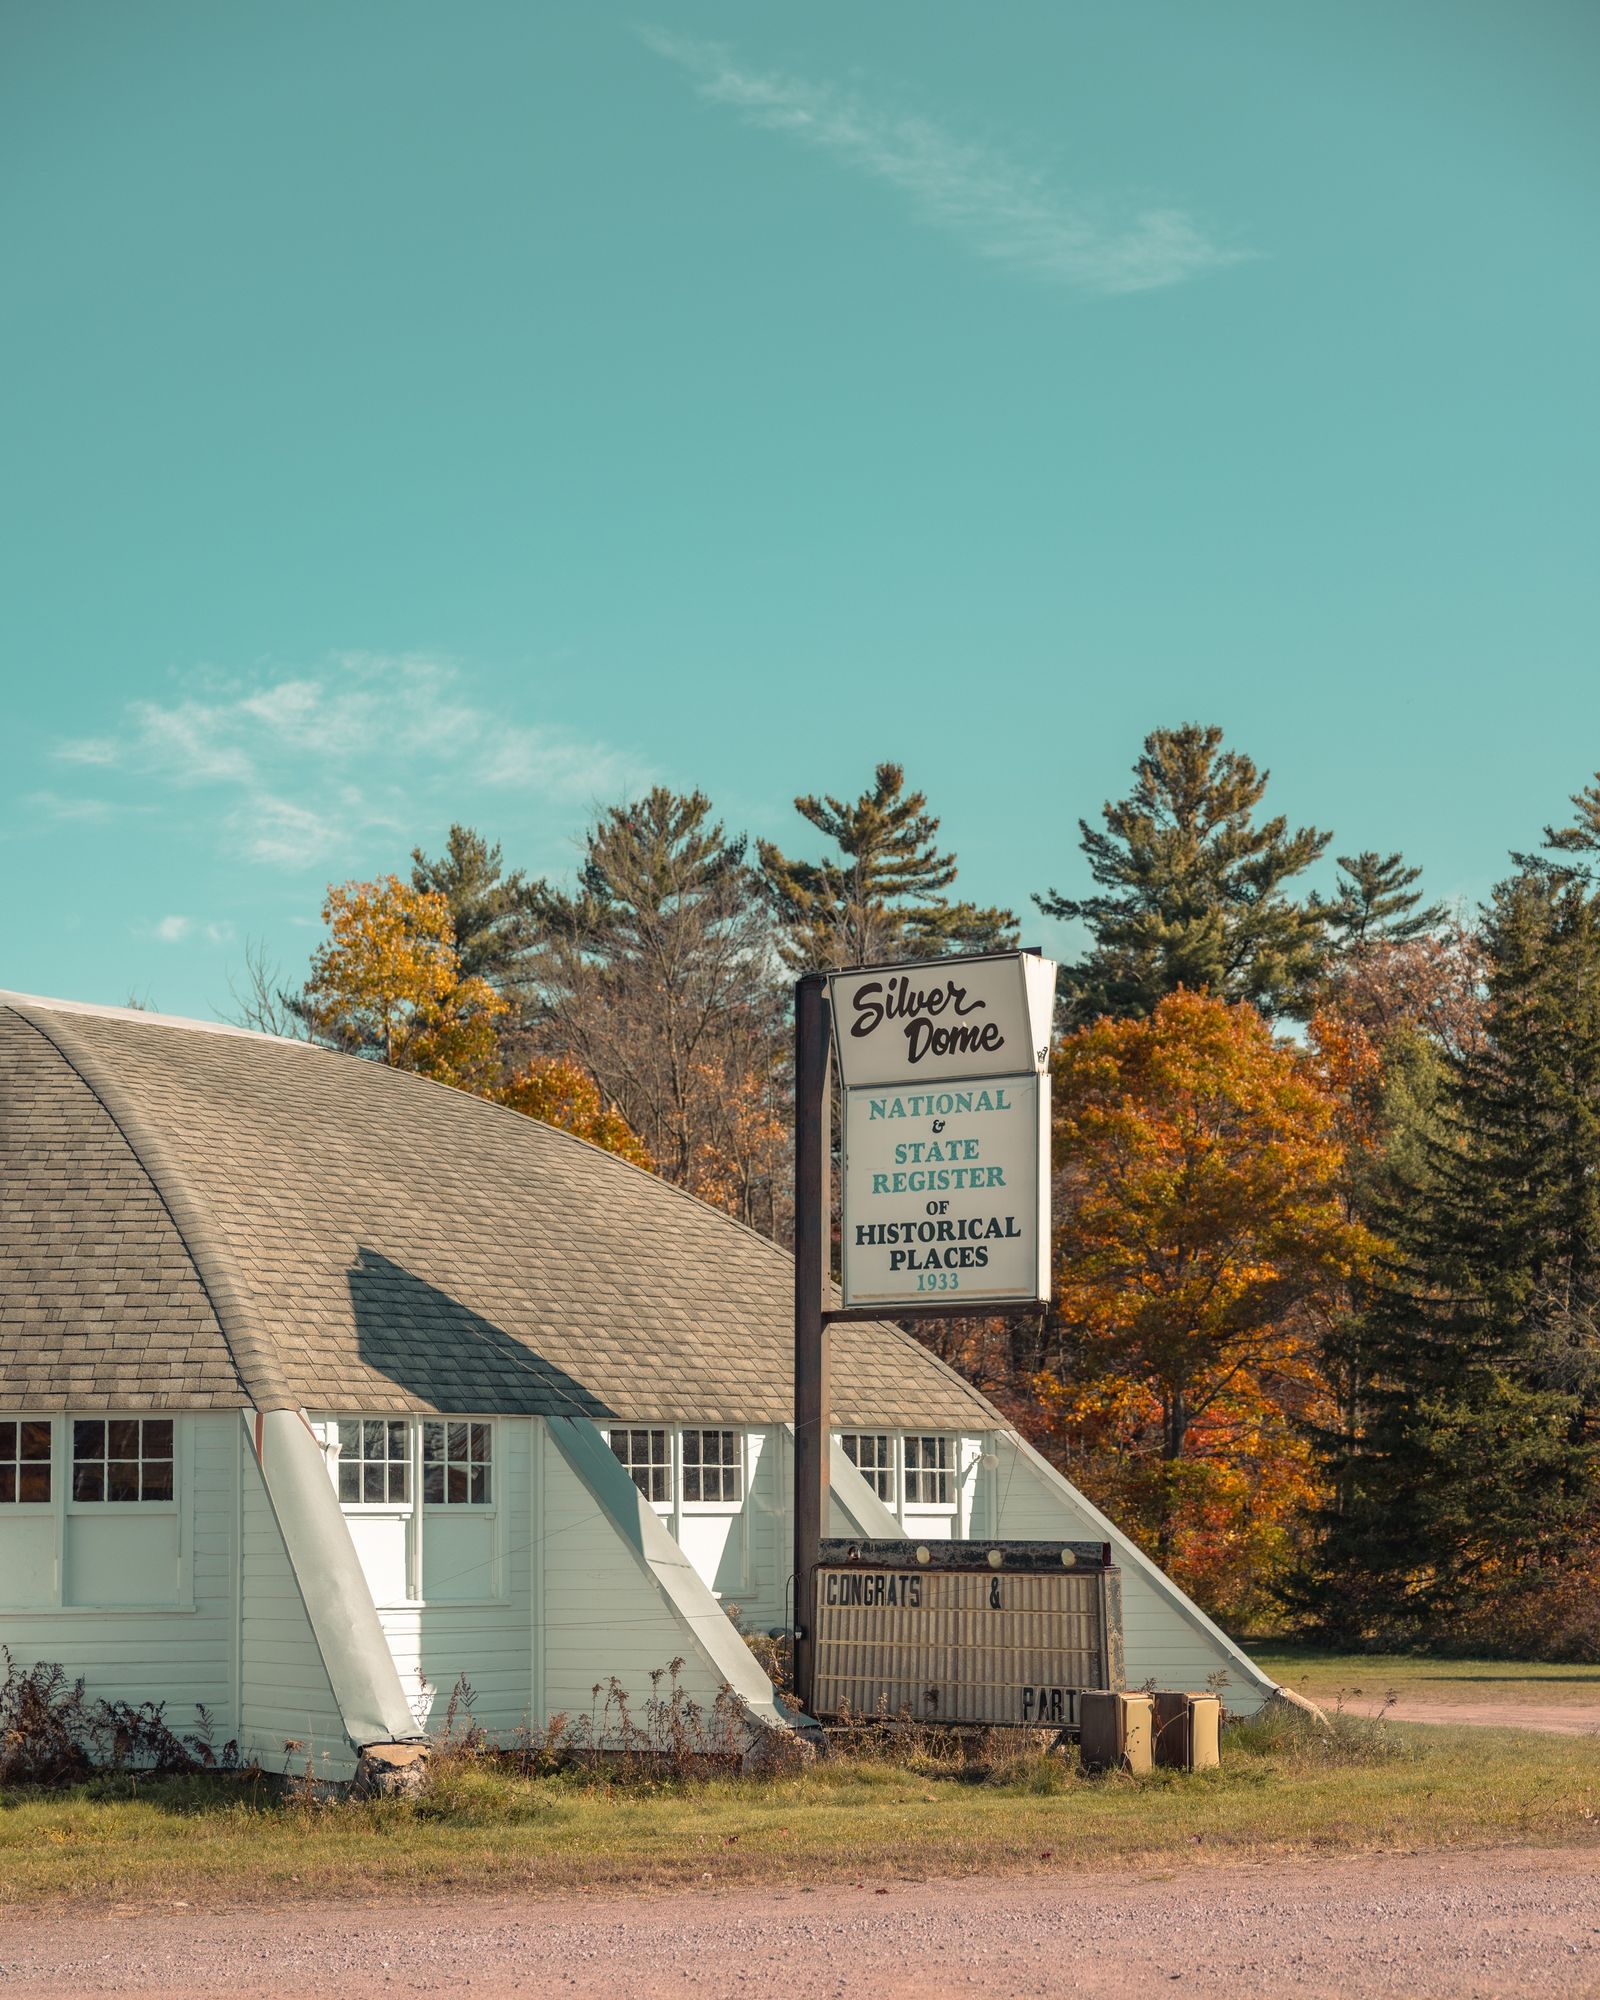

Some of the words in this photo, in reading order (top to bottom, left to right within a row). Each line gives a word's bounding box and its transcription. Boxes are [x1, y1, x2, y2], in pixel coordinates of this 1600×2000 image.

[851, 976, 985, 1037] Silver
[904, 1017, 1004, 1064] Dome
[869, 1089, 1011, 1120] NATIONAL
[932, 1119, 945, 1133] &
[895, 1139, 979, 1165] STATE
[872, 1166, 1006, 1194] REGISTER
[926, 1201, 949, 1215] OF
[855, 1217, 1021, 1245] HISTORICAL
[889, 1246, 988, 1271] PLACES
[916, 1273, 959, 1291] 1933
[827, 1574, 920, 1607] CONGRATS
[990, 1577, 1001, 1609] &
[1023, 1687, 1094, 1722] PART
